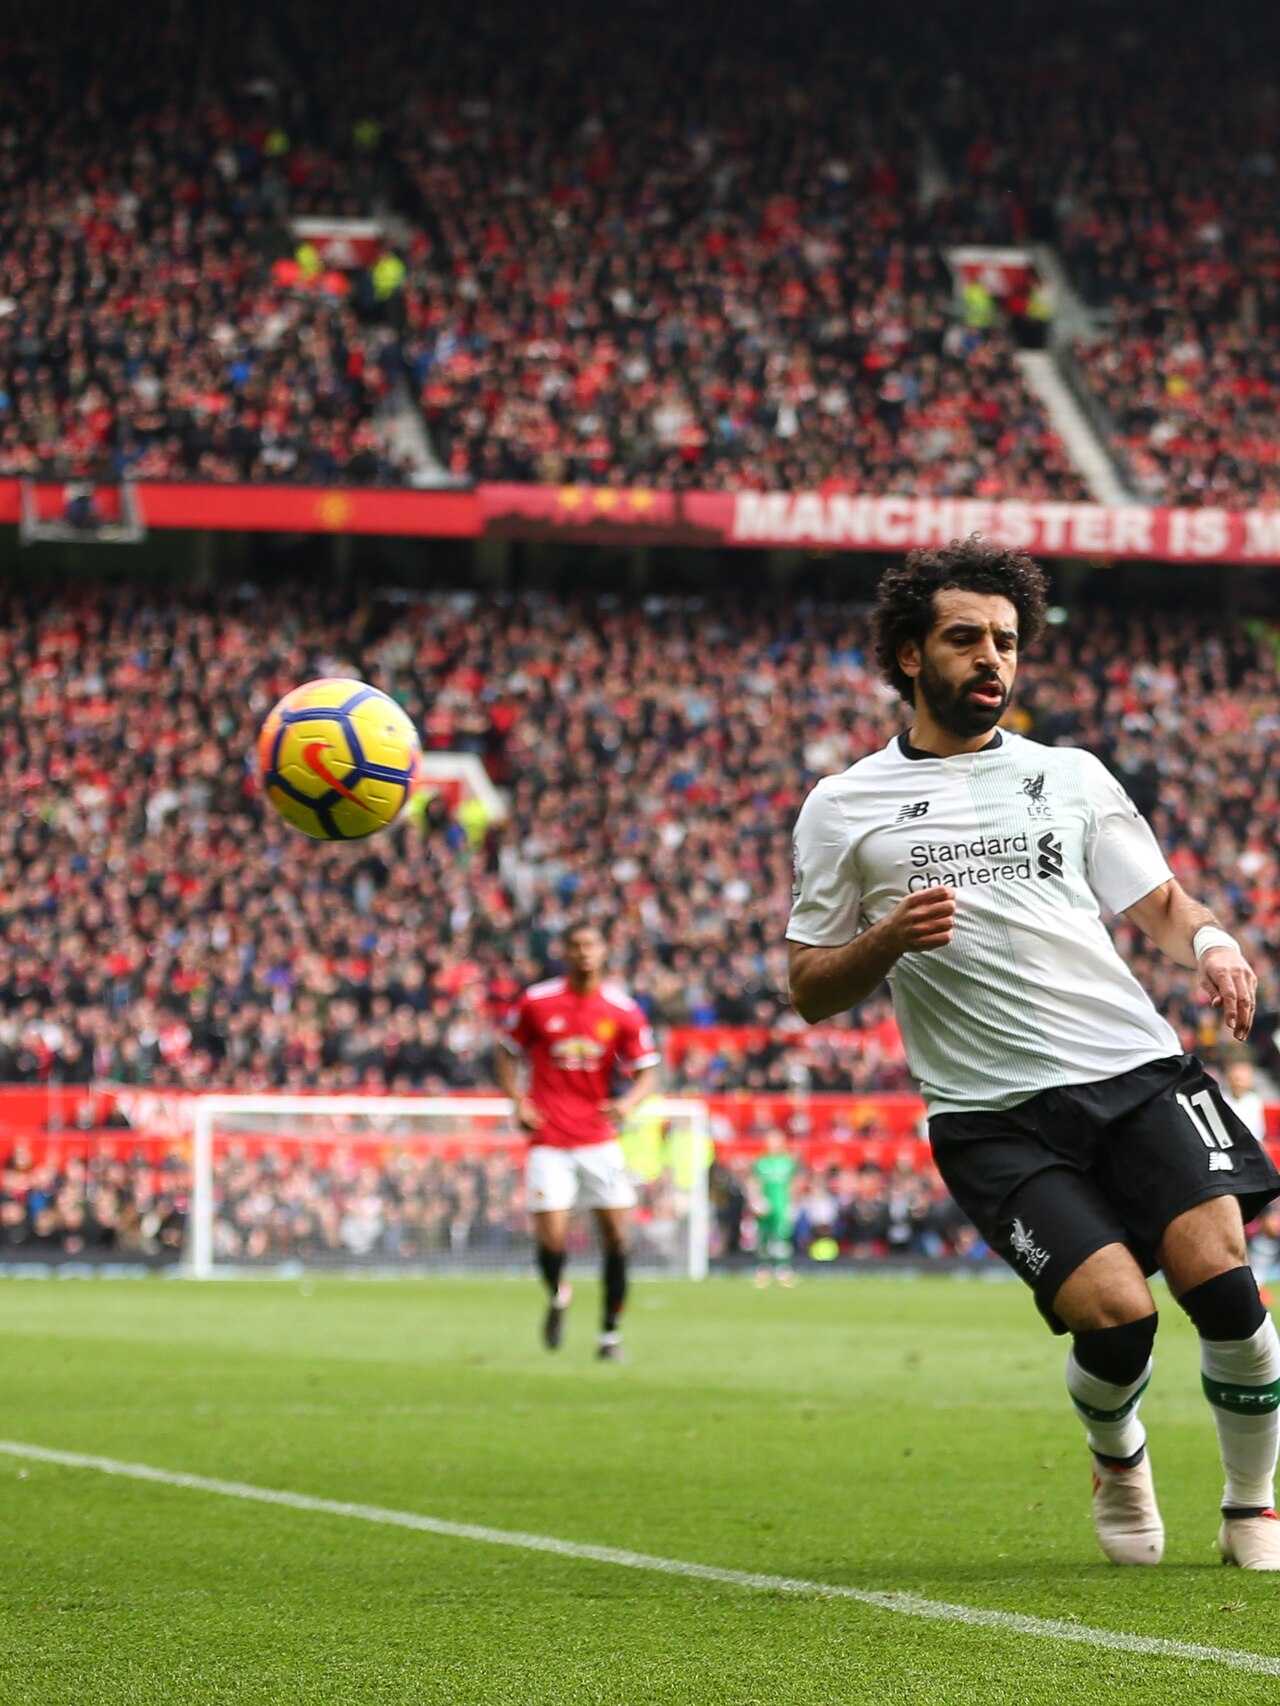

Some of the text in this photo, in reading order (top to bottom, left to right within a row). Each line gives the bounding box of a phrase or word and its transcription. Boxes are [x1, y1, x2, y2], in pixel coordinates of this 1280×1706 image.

[733, 490, 1152, 553] MANCHESTER
[1168, 508, 1231, 556] IS
[910, 832, 1028, 868] Standard
[907, 858, 1031, 893] Chartered
[1175, 1089, 1234, 1150] 11
